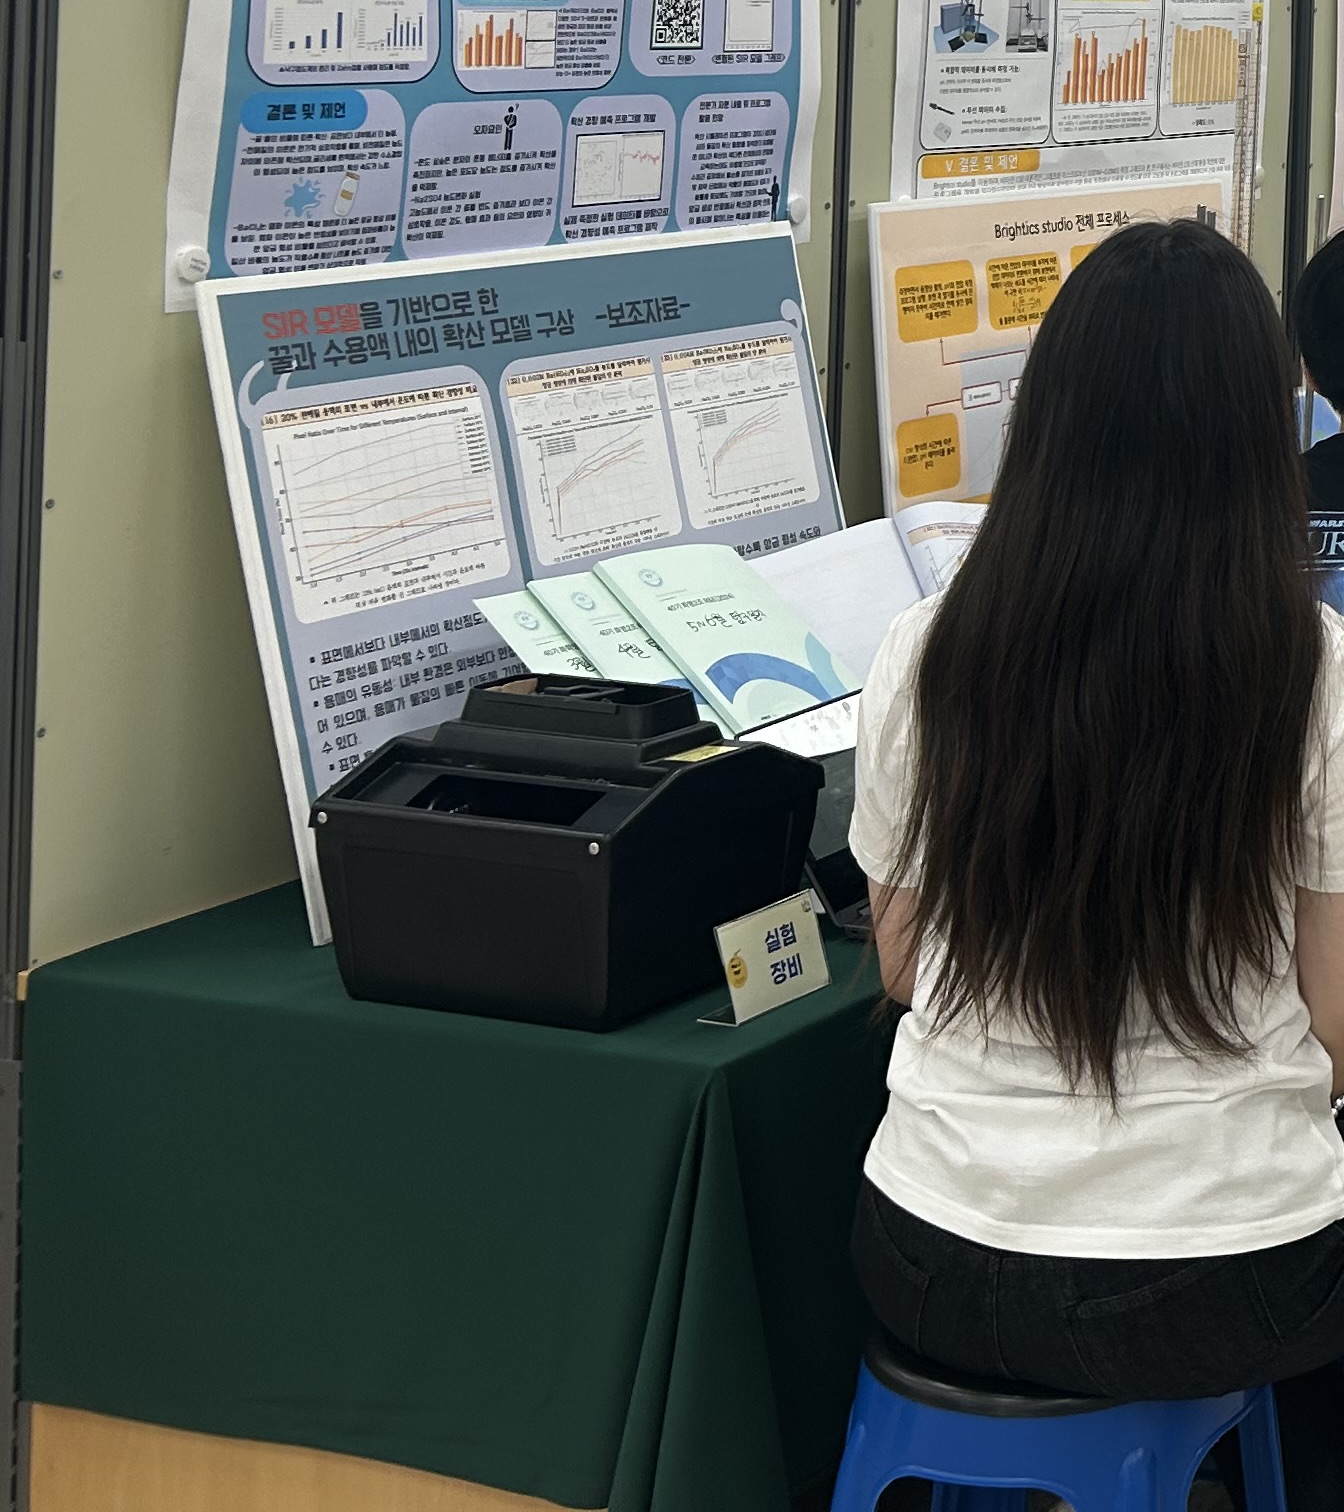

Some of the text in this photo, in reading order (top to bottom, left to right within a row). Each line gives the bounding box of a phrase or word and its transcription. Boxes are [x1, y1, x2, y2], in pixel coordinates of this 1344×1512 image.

[267, 102, 346, 121] 결론 및 제언
[958, 153, 1018, 172] 결론 및 제언
[994, 210, 1130, 241] Brightics studio 전체 프로세스
[262, 287, 500, 341] SIR 모델을 기반으로 한
[268, 295, 691, 376] 꿀과 수용액 내의 확산 모델 구상 -보조자료-
[799, 525, 821, 539] 속도와
[320, 636, 386, 665] 표면에서보다
[389, 625, 441, 647] 내부에서의
[309, 641, 451, 691] 다는 경향성을 파악할 수 있다.
[323, 690, 358, 709] 용매의
[399, 671, 420, 687] 내부
[423, 662, 454, 681] 환경은
[457, 649, 496, 672] 외부보다
[317, 719, 328, 733] 어
[334, 708, 371, 728] 있으며,
[374, 696, 406, 716] 용매가
[321, 733, 362, 754] 수 있다.
[765, 921, 797, 953] 실험
[770, 953, 803, 985] 장비
